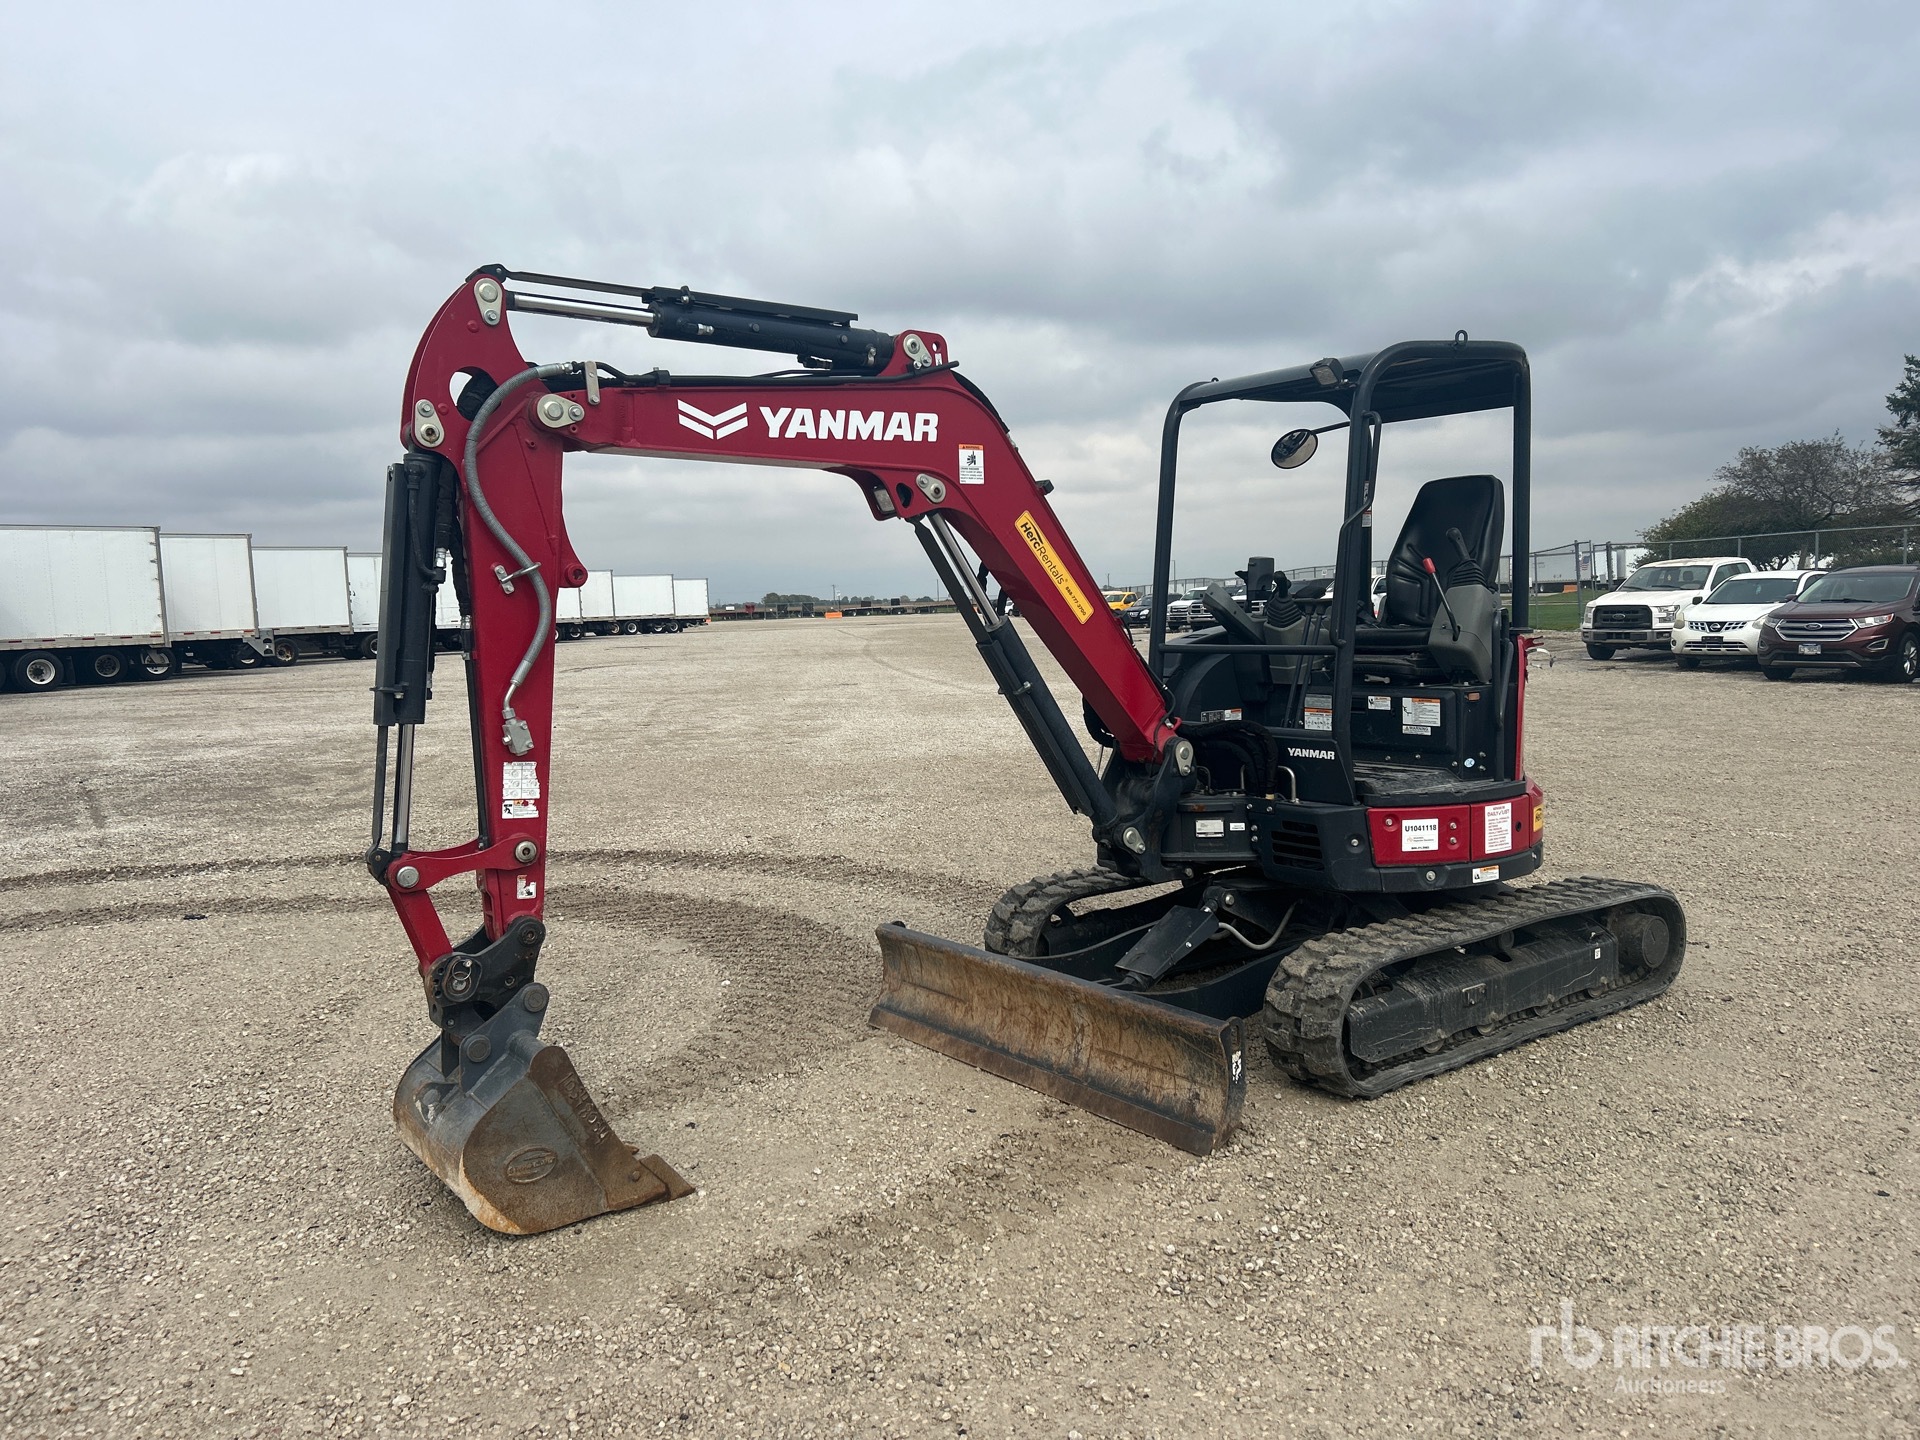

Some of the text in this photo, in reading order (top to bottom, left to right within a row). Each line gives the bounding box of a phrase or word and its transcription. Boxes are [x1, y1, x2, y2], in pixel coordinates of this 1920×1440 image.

[759, 406, 939, 442] YANMAR
[1287, 747, 1335, 760] YANMAR
[1404, 824, 1437, 832] U1041118
